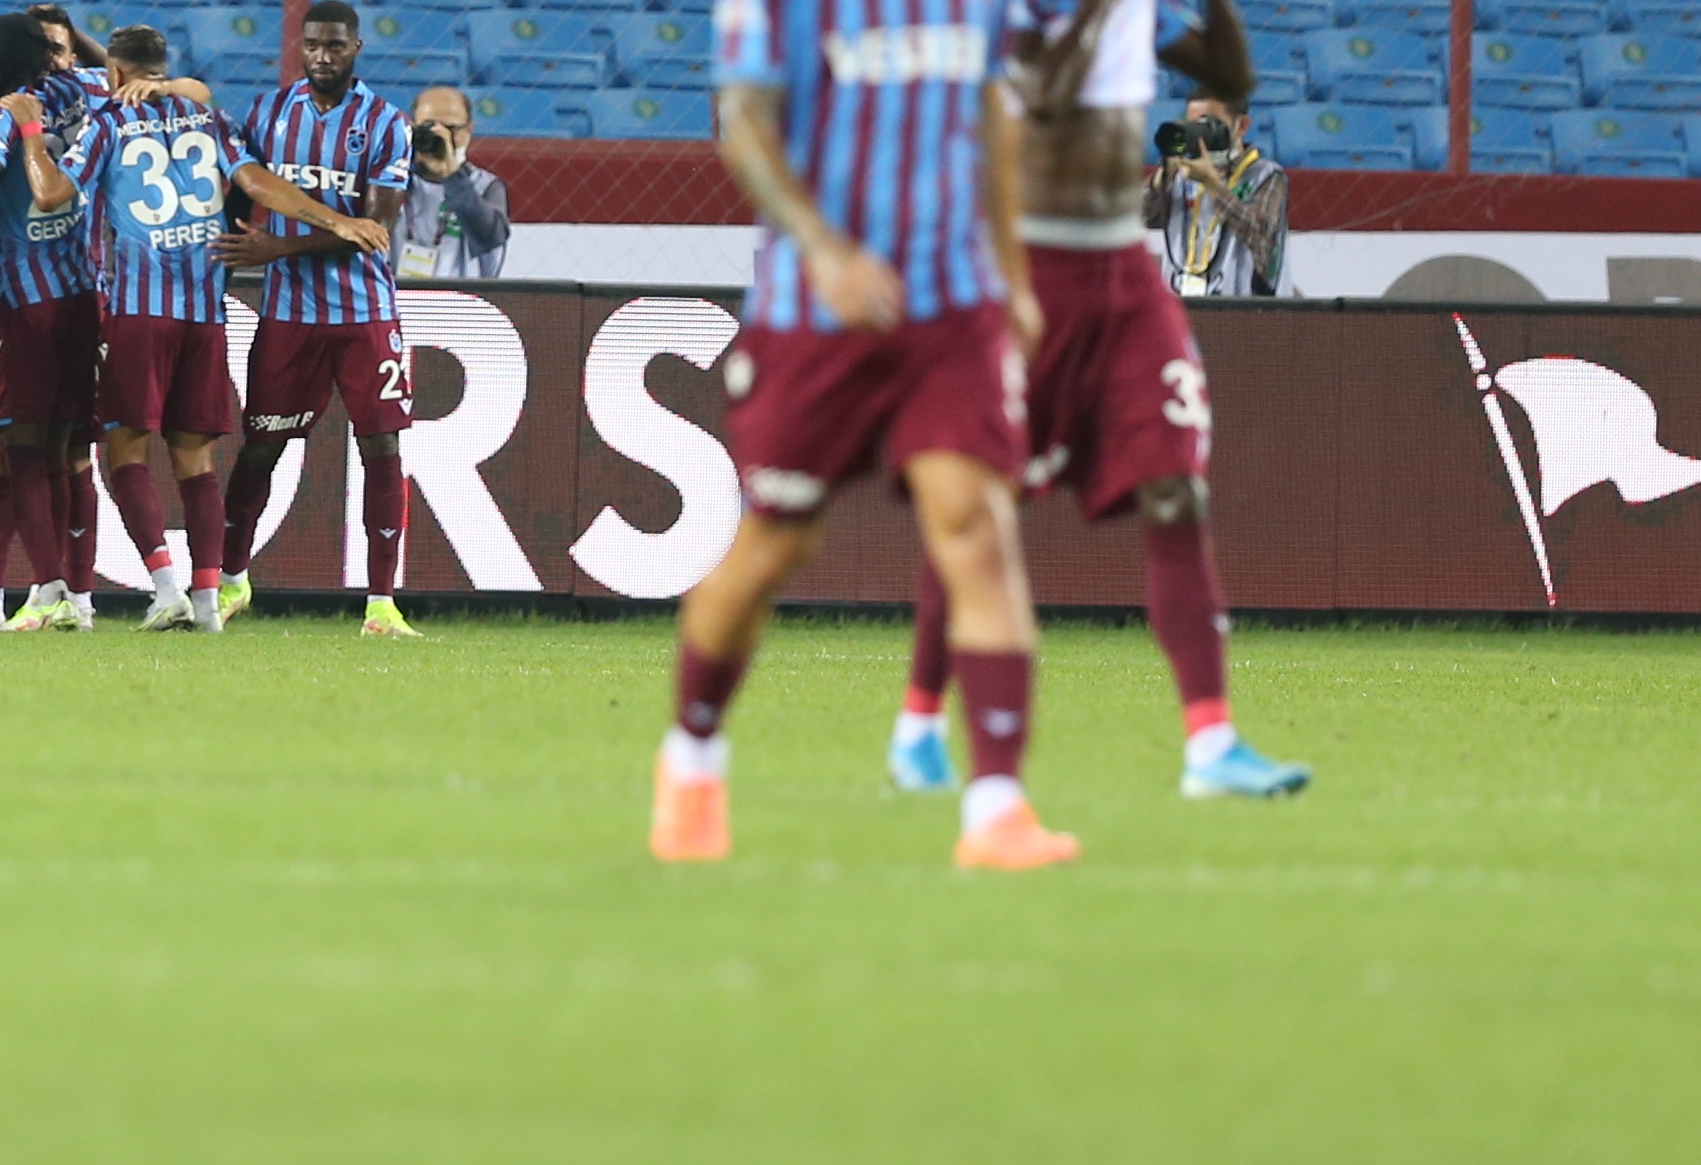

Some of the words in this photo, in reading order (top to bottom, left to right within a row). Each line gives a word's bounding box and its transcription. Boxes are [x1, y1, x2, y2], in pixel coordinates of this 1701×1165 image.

[121, 130, 225, 226] 33
[267, 162, 361, 197] VESTEL
[149, 218, 222, 251] PERES
